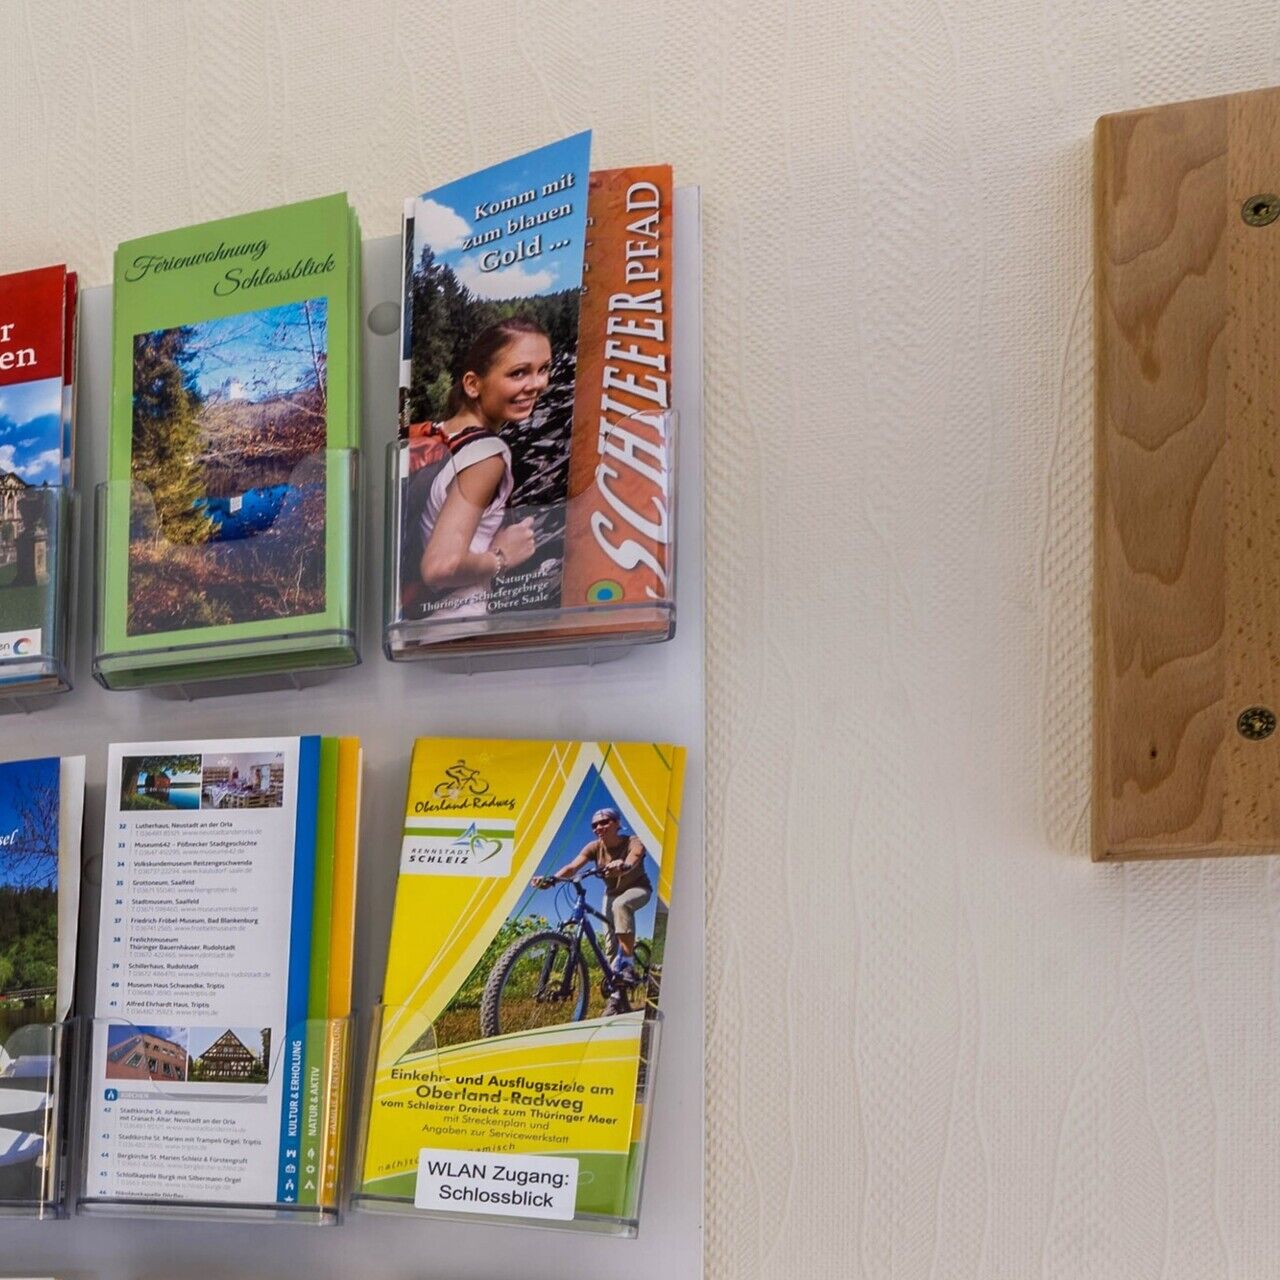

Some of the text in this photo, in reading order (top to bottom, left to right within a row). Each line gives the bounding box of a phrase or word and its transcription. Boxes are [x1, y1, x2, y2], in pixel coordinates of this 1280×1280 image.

[474, 172, 576, 220] Komm mit
[462, 204, 572, 251] zum blauen
[124, 239, 269, 282] Ferienwohnung
[214, 253, 336, 297] Schlossblick
[590, 181, 669, 600] SCHIEFERPFAD
[495, 570, 548, 586] Naturpark
[409, 855, 468, 864] SCHLEIZ
[291, 1041, 302, 1091] ERHOLUNG
[391, 1069, 614, 1095] Einkehr- und Ausflugsziele am
[380, 1099, 618, 1125] vom Schleizer Dreieck zum Thüringer Meer
[416, 1085, 584, 1113] Oberland-Radweg
[288, 1100, 298, 1136] KULTUR
[443, 1114, 550, 1130] mit Streckenplan und
[422, 1124, 569, 1144] Angaben zur Servicewerkstatt
[428, 1161, 570, 1189] WLAN Zugang:
[439, 1184, 553, 1208] Schlossblick
